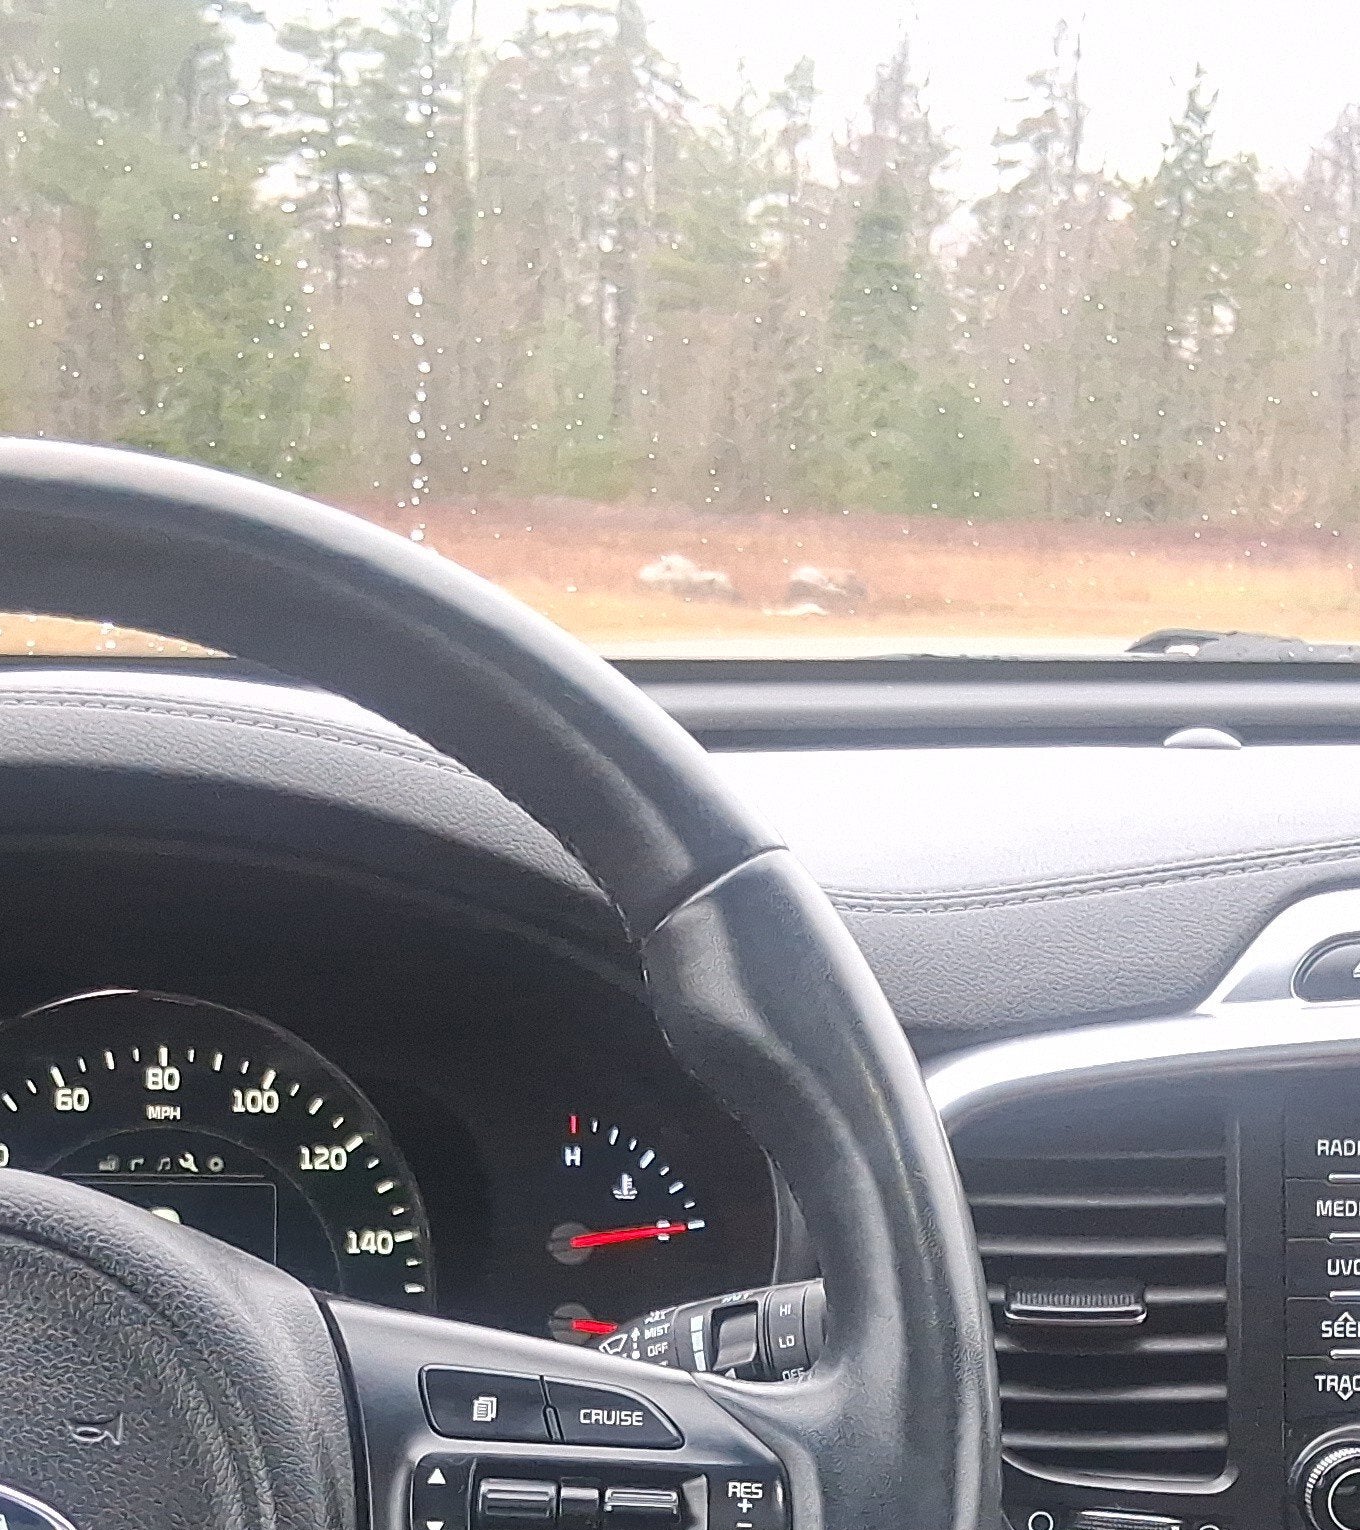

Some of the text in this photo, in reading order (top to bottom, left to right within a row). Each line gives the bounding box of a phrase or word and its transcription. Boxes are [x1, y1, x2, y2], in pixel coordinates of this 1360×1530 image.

[145, 1066, 181, 1090] 80
[54, 1086, 90, 1112] 60
[232, 1089, 279, 1113] 100
[146, 1105, 181, 1120] MPH
[300, 1146, 347, 1171] 120
[564, 1146, 581, 1166] H
[347, 1230, 394, 1255] 140
[779, 1304, 792, 1317] HI
[644, 1323, 671, 1340] MIST
[648, 1342, 668, 1357] OFF
[778, 1335, 795, 1349] LO
[579, 1409, 644, 1427] CRUISE
[728, 1482, 763, 1498] RES
